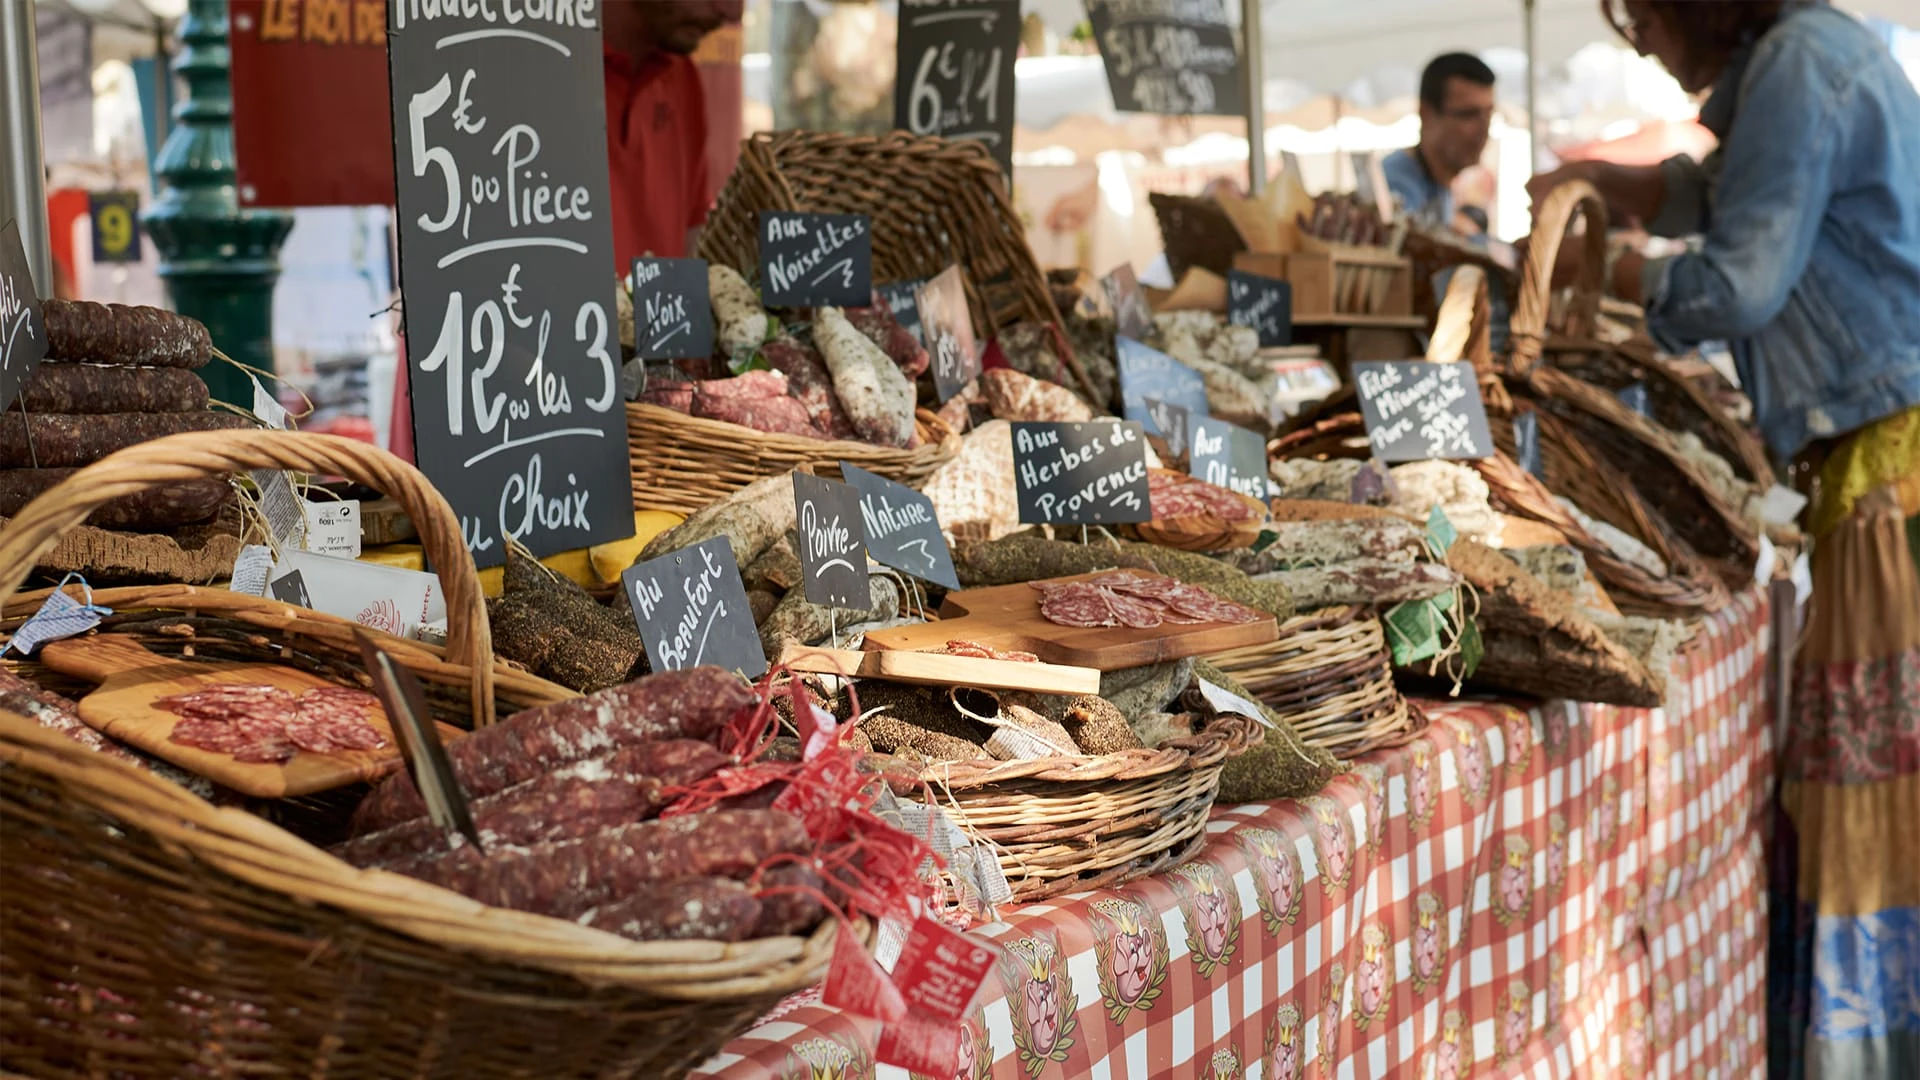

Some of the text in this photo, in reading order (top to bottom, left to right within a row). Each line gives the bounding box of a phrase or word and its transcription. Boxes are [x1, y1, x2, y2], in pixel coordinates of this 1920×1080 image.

[491, 123, 593, 228] Pièce
[97, 205, 132, 254] 9
[767, 219, 865, 294] Noisettes
[768, 216, 807, 243] Aux
[636, 261, 661, 287] Aux
[645, 291, 687, 337] Noix
[524, 309, 573, 416] les
[574, 301, 616, 413] 3
[1017, 428, 1060, 454] Aux
[1020, 434, 1105, 490] Herbes
[1109, 423, 1137, 447] de
[1194, 426, 1224, 458] Aux
[499, 453, 591, 542] Choix
[1034, 460, 1147, 522] Provence
[802, 499, 849, 563] Poivre
[635, 577, 664, 620] Au
